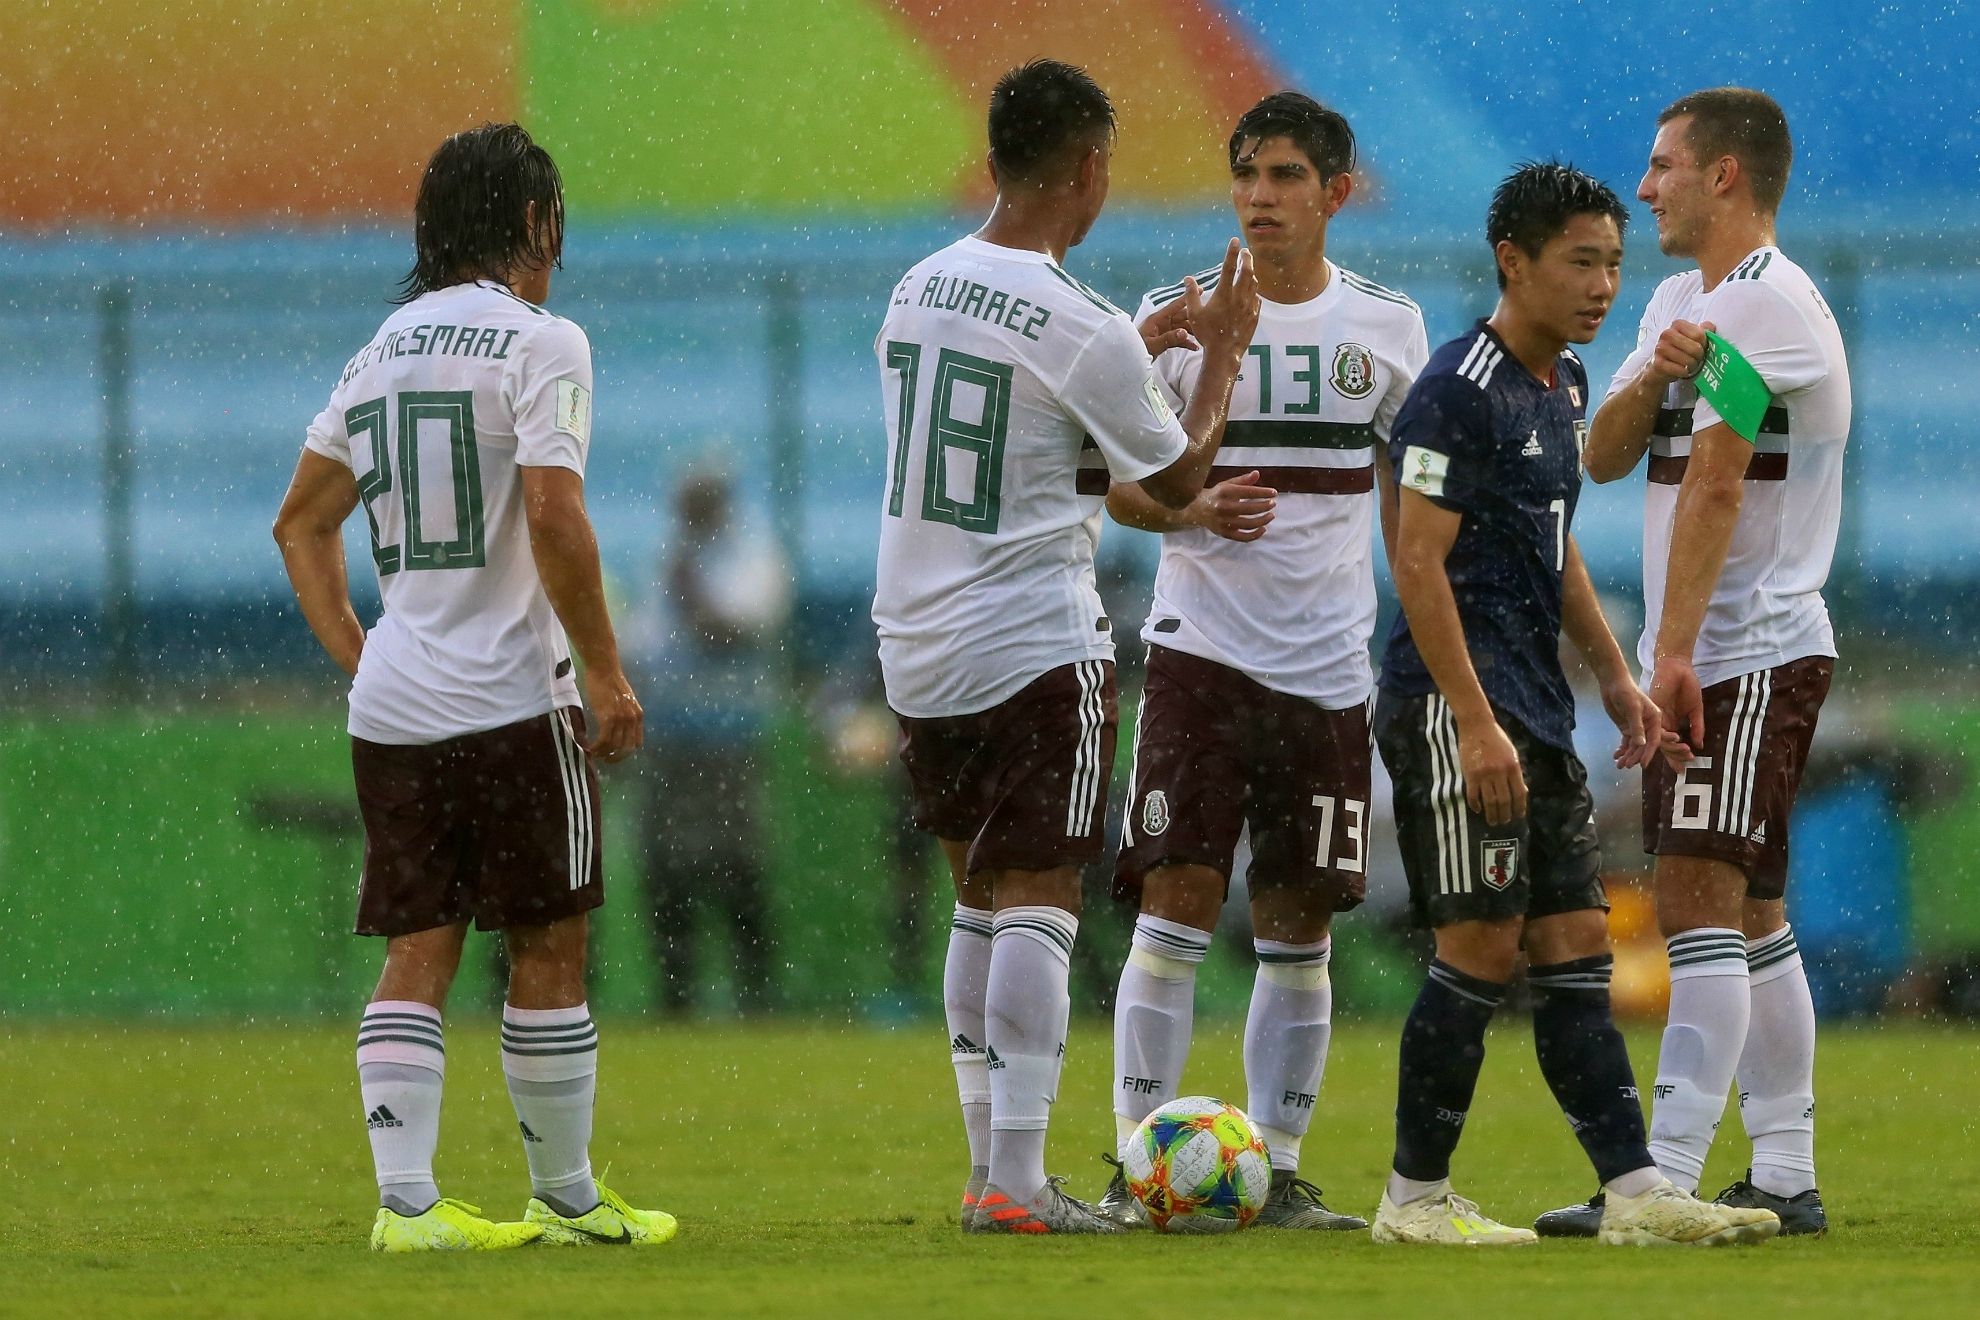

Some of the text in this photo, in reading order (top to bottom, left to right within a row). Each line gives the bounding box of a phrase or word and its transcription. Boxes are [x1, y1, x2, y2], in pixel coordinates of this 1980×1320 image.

[919, 270, 1051, 341] ÁLVAREZ
[1248, 345, 1320, 414] 13
[887, 341, 1014, 534] 18
[345, 391, 485, 576] 20
[1671, 756, 1712, 830] 6
[1312, 795, 1365, 872] 13
[1123, 1076, 1162, 1094] FMF
[1283, 1090, 1316, 1109] FMF
